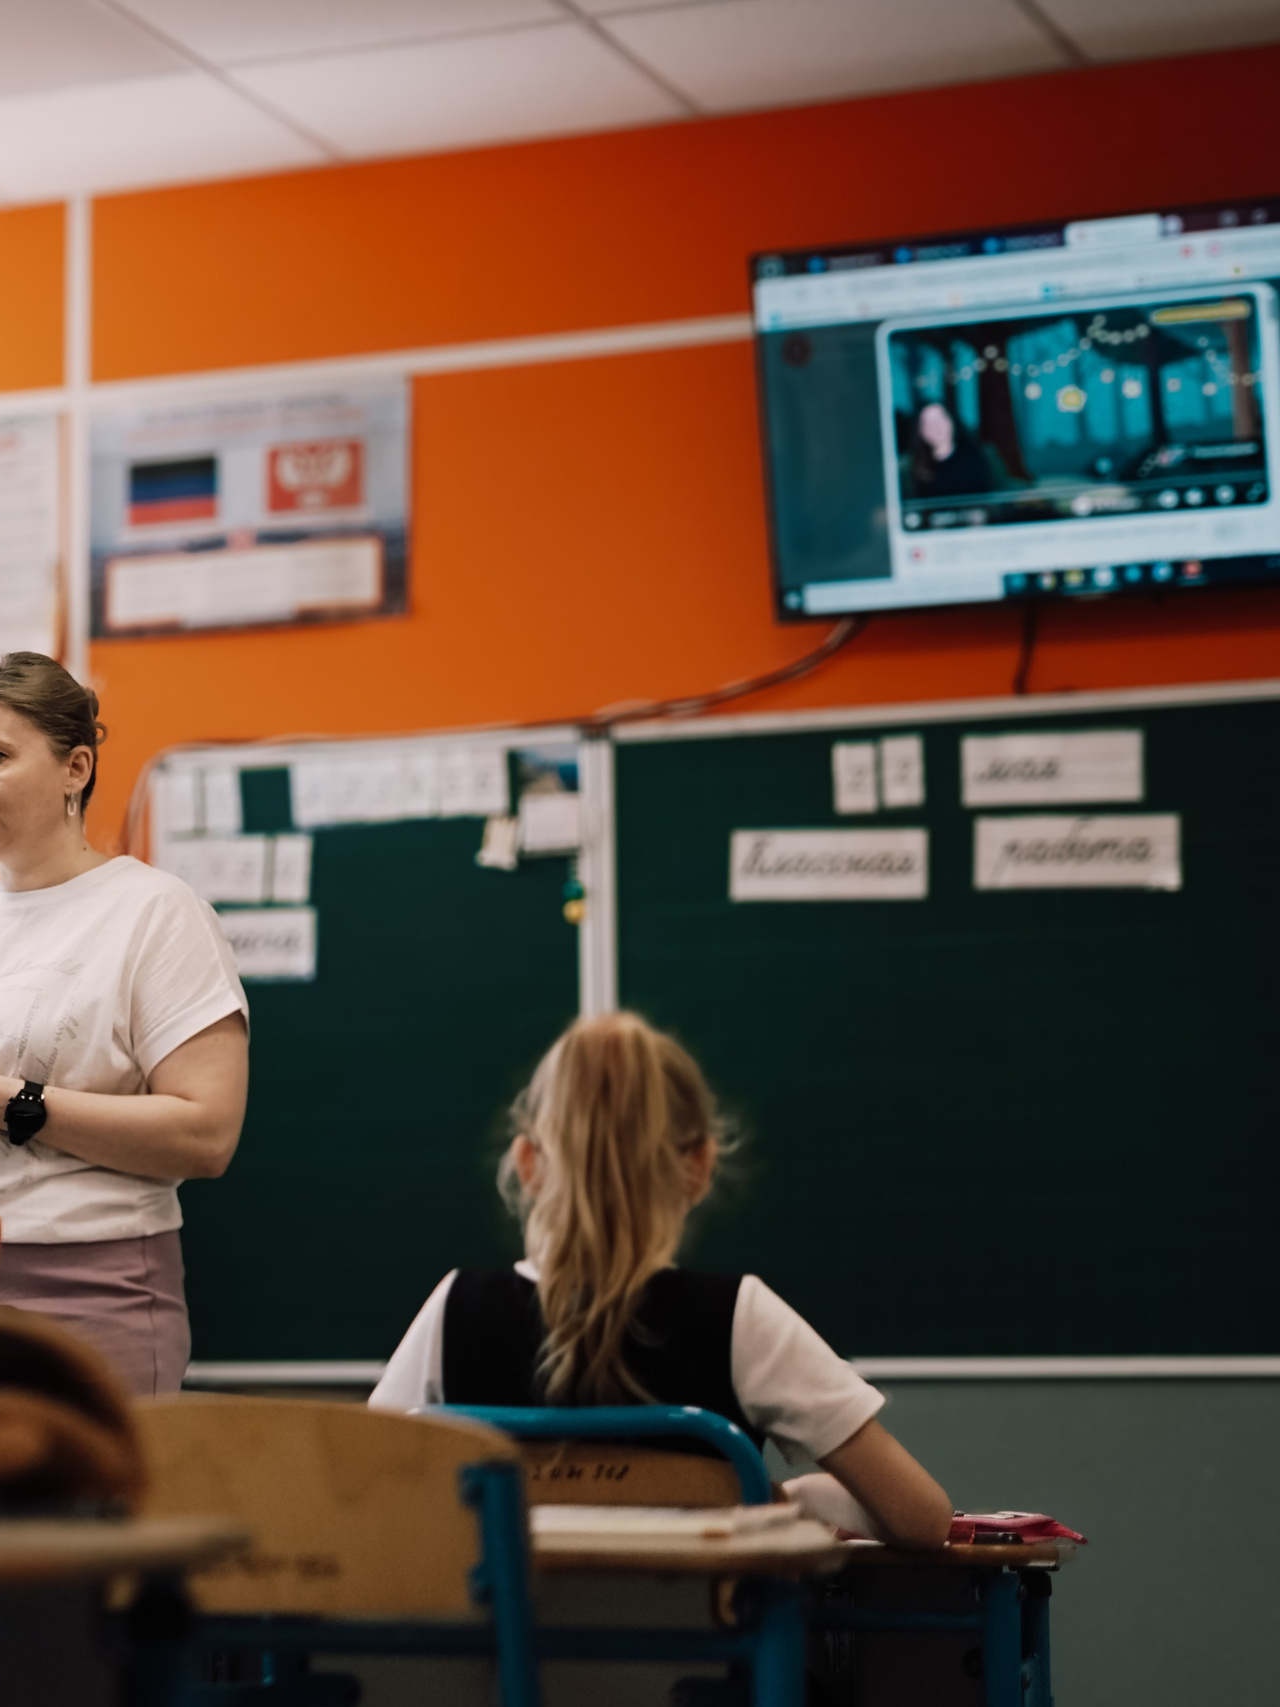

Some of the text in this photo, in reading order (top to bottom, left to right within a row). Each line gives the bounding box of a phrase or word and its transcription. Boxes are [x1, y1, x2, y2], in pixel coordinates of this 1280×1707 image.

[974, 756, 1063, 783] мая
[740, 817, 1157, 886] Классная работа
